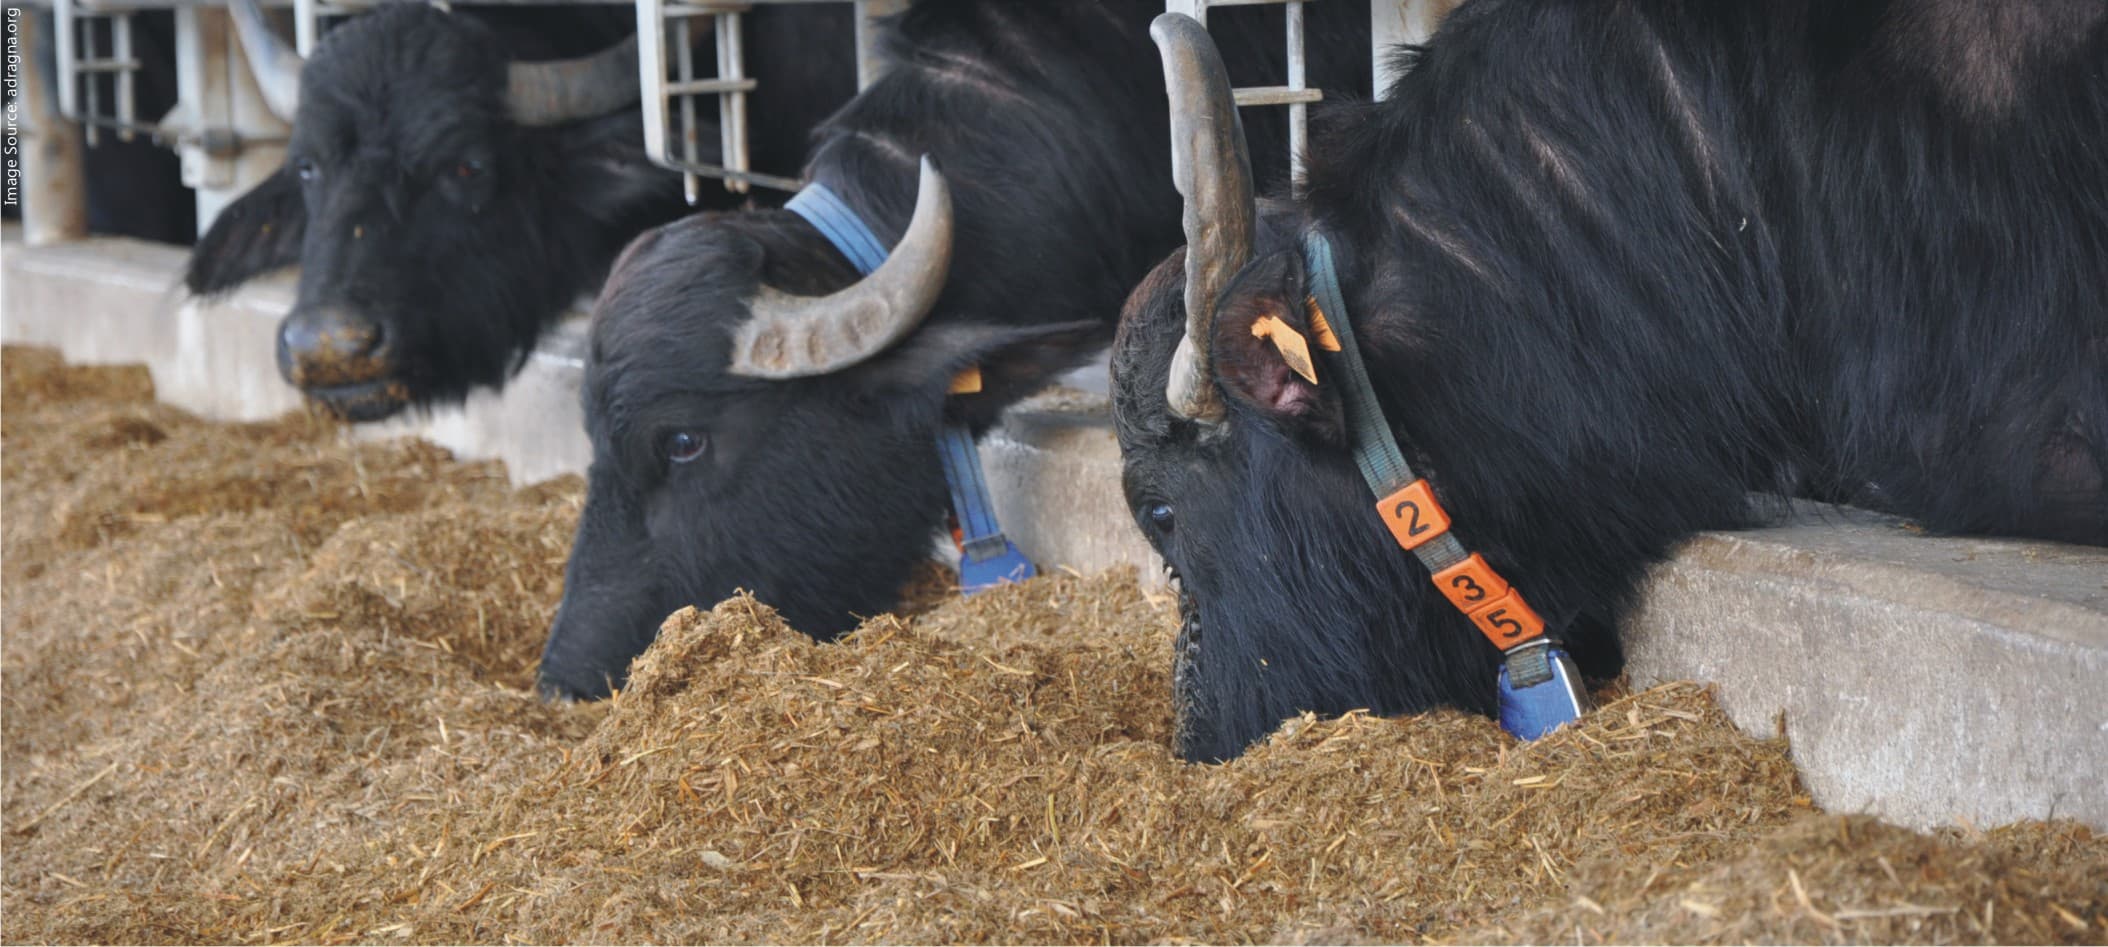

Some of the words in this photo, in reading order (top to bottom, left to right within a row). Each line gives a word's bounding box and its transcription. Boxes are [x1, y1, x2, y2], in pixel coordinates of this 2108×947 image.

[1395, 500, 1430, 537] 2
[1452, 574, 1486, 602] 3
[1486, 609, 1522, 638] 5
